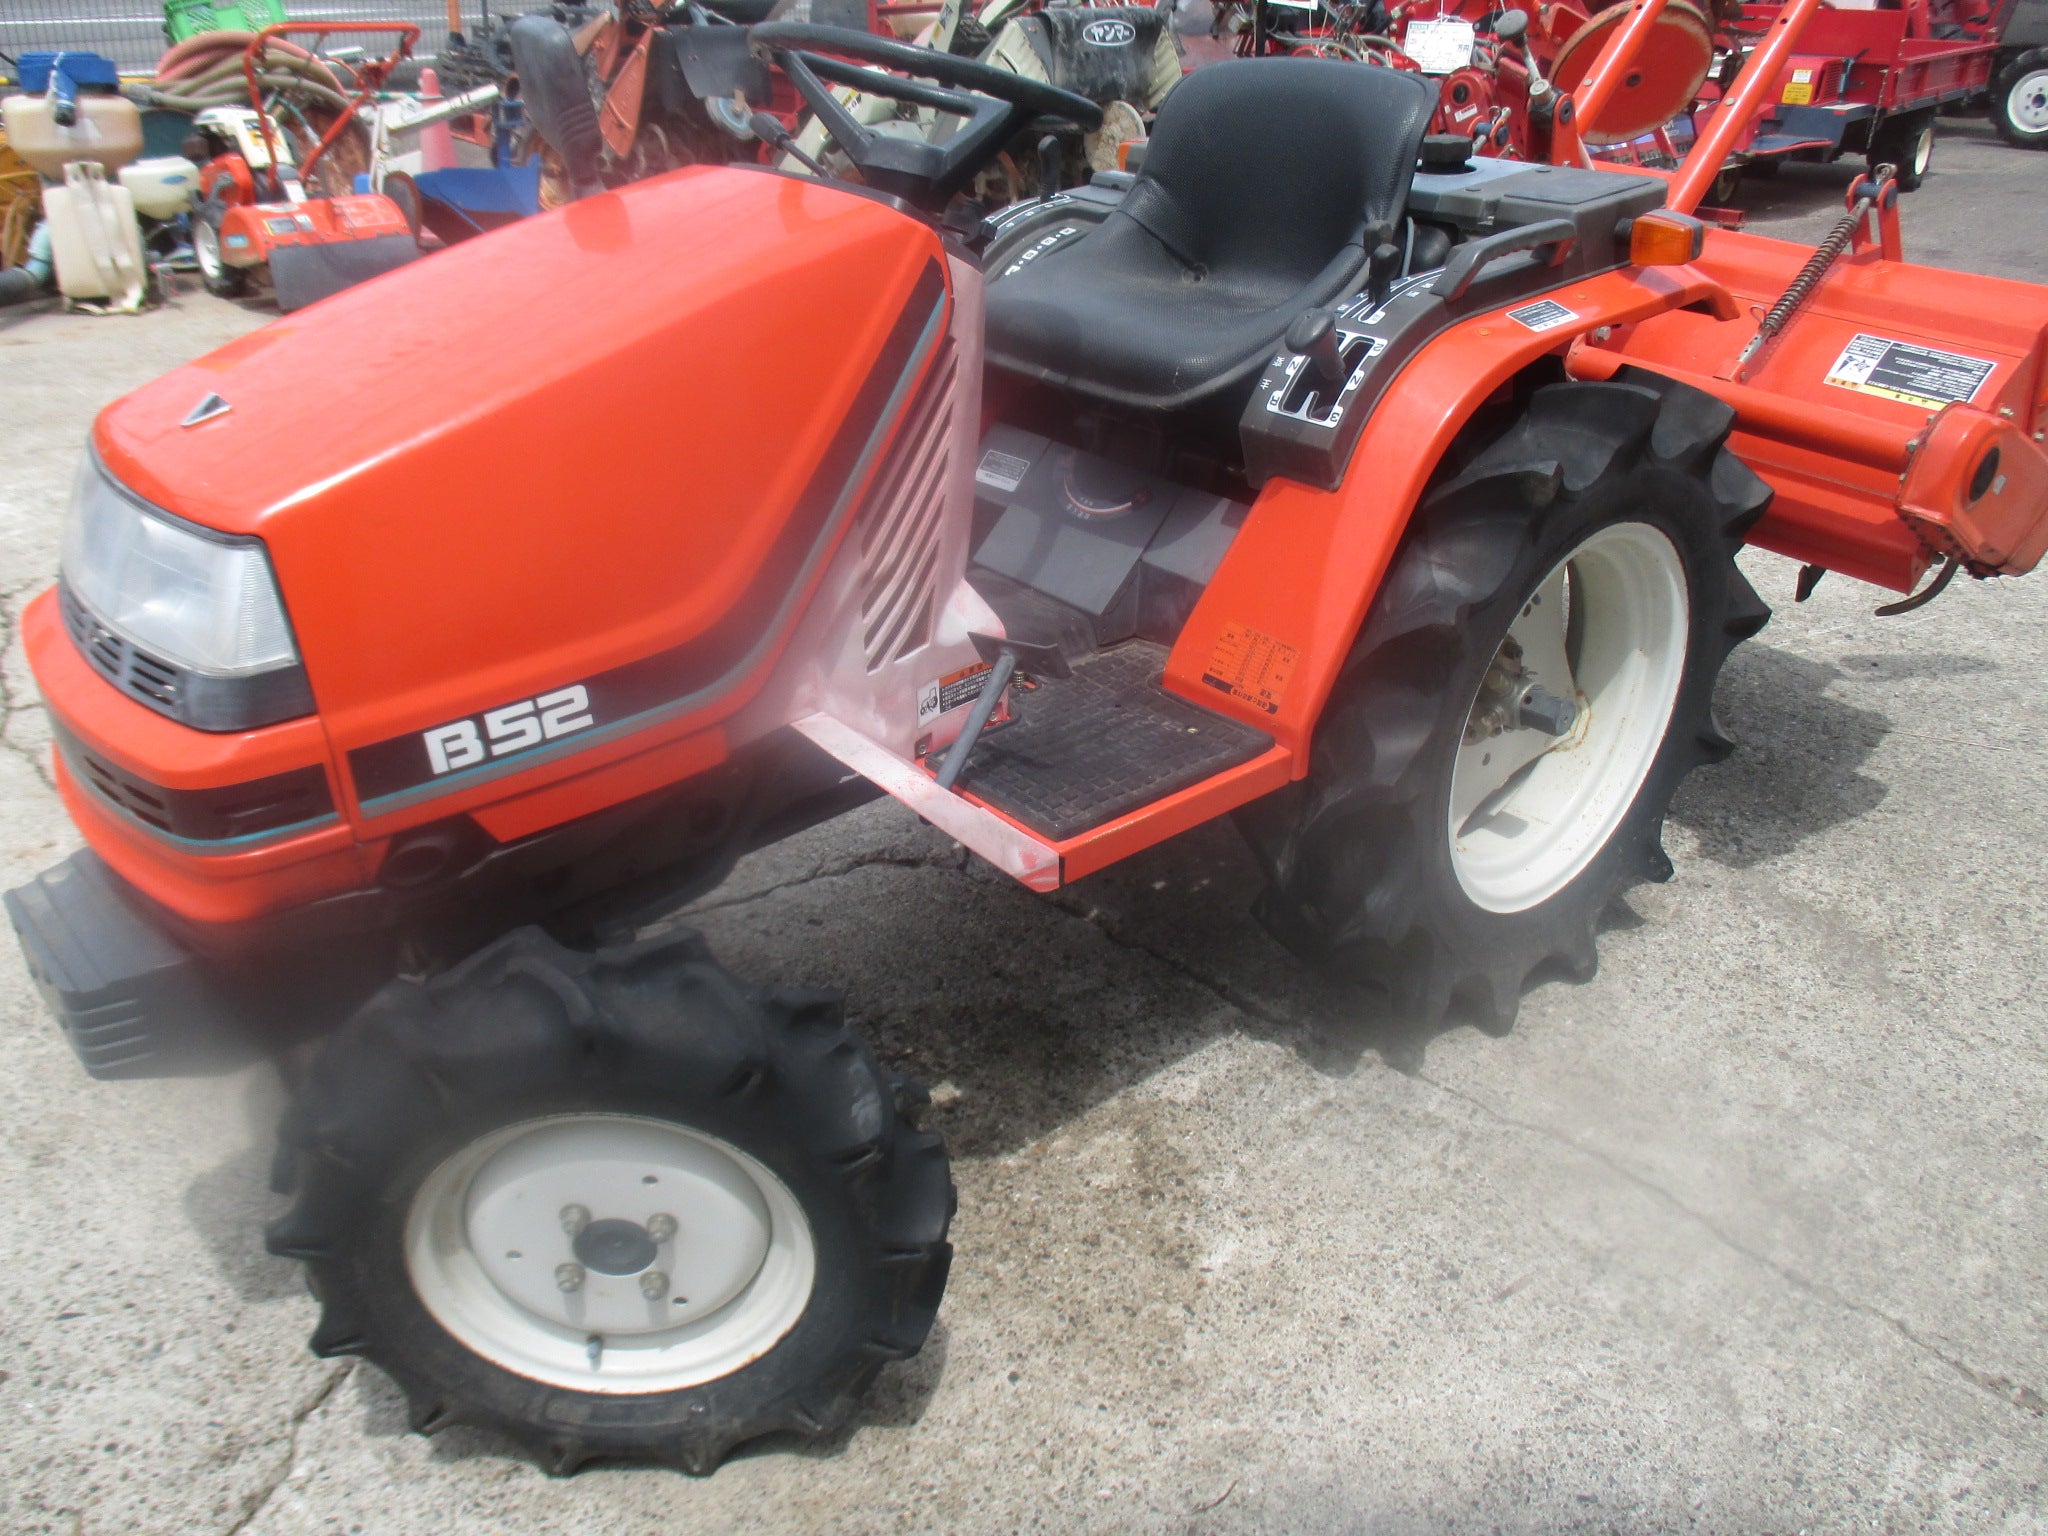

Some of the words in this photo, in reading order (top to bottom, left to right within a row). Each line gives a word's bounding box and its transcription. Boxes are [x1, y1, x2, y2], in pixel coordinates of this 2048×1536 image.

[1091, 25, 1130, 41] ヤンマー
[1350, 375, 1361, 385] N
[1330, 412, 1340, 423] 3
[423, 684, 594, 775] B52
